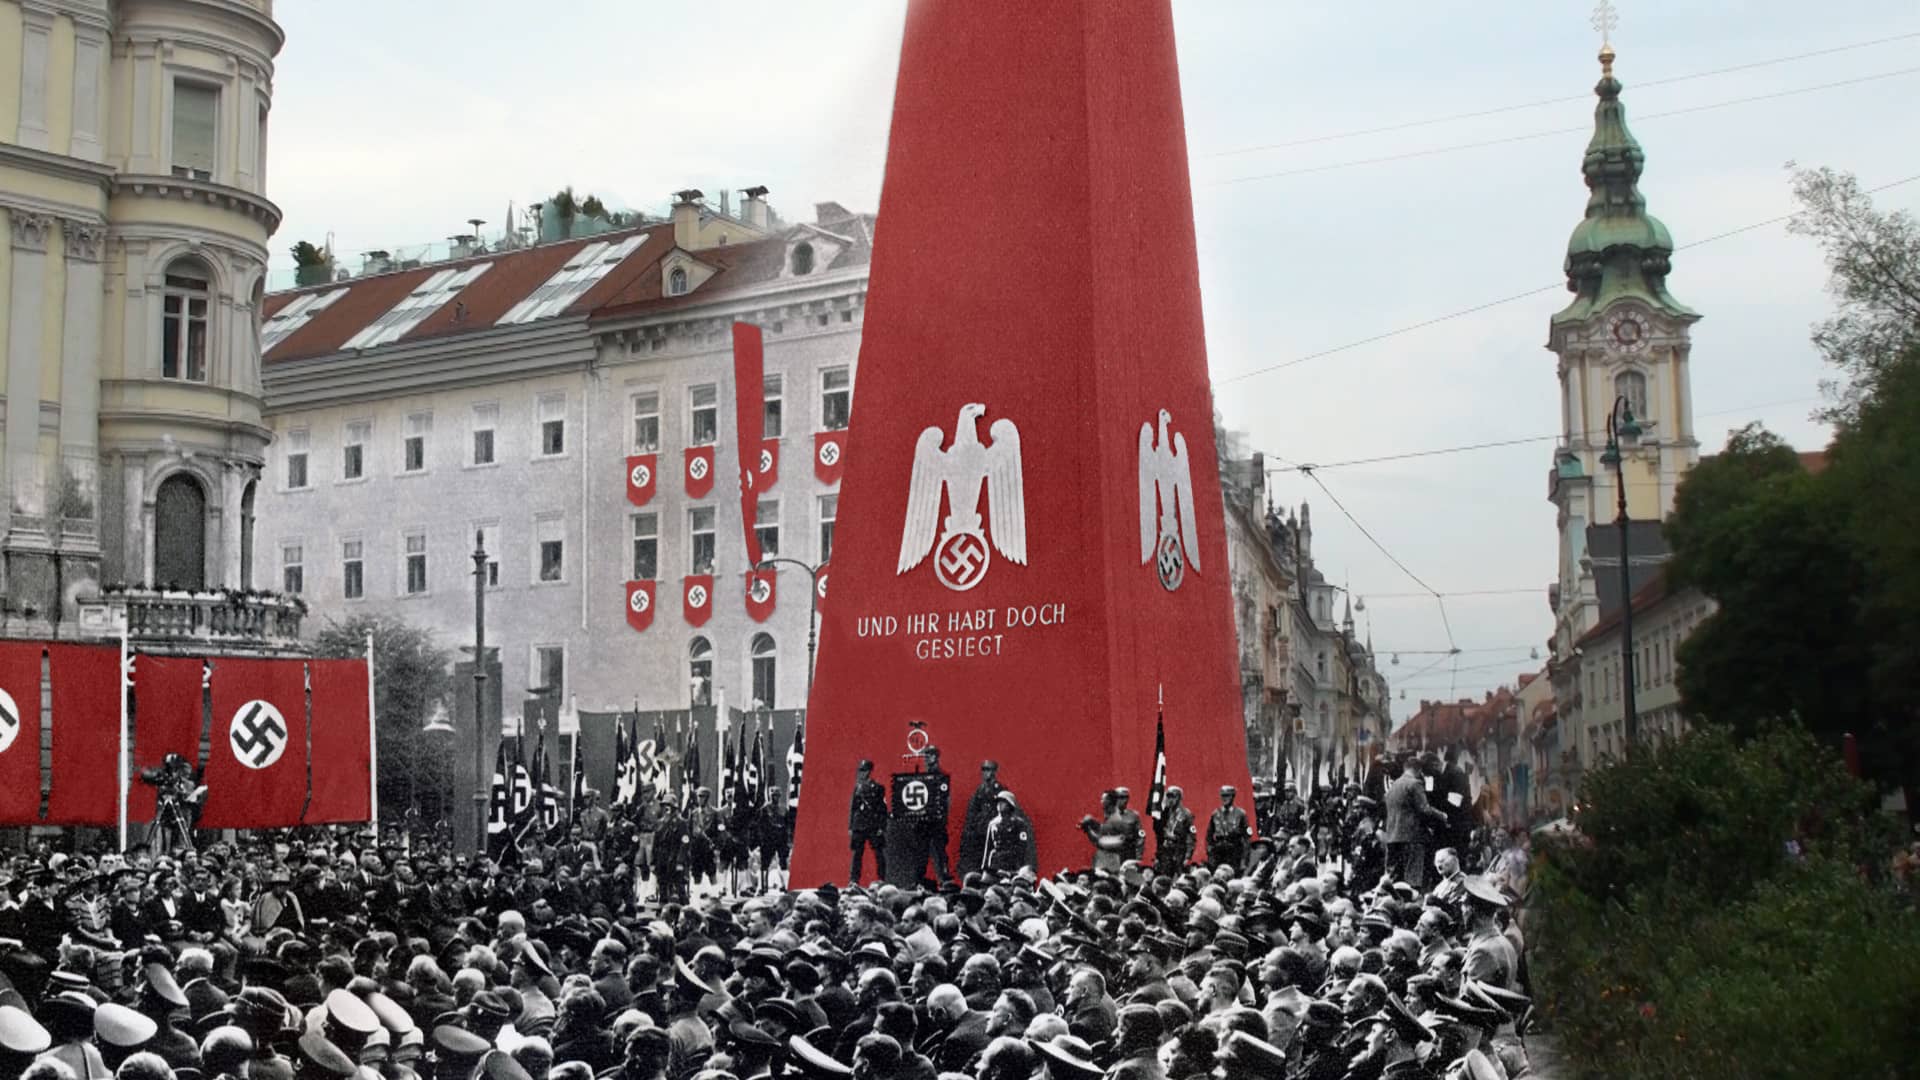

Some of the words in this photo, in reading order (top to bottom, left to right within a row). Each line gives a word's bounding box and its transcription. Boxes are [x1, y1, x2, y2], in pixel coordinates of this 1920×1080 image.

[857, 616, 898, 638] UND
[906, 612, 940, 635] IHR
[947, 608, 996, 632] HABT
[1006, 602, 1066, 628] DOCH
[915, 634, 1004, 660] GESIEGT
